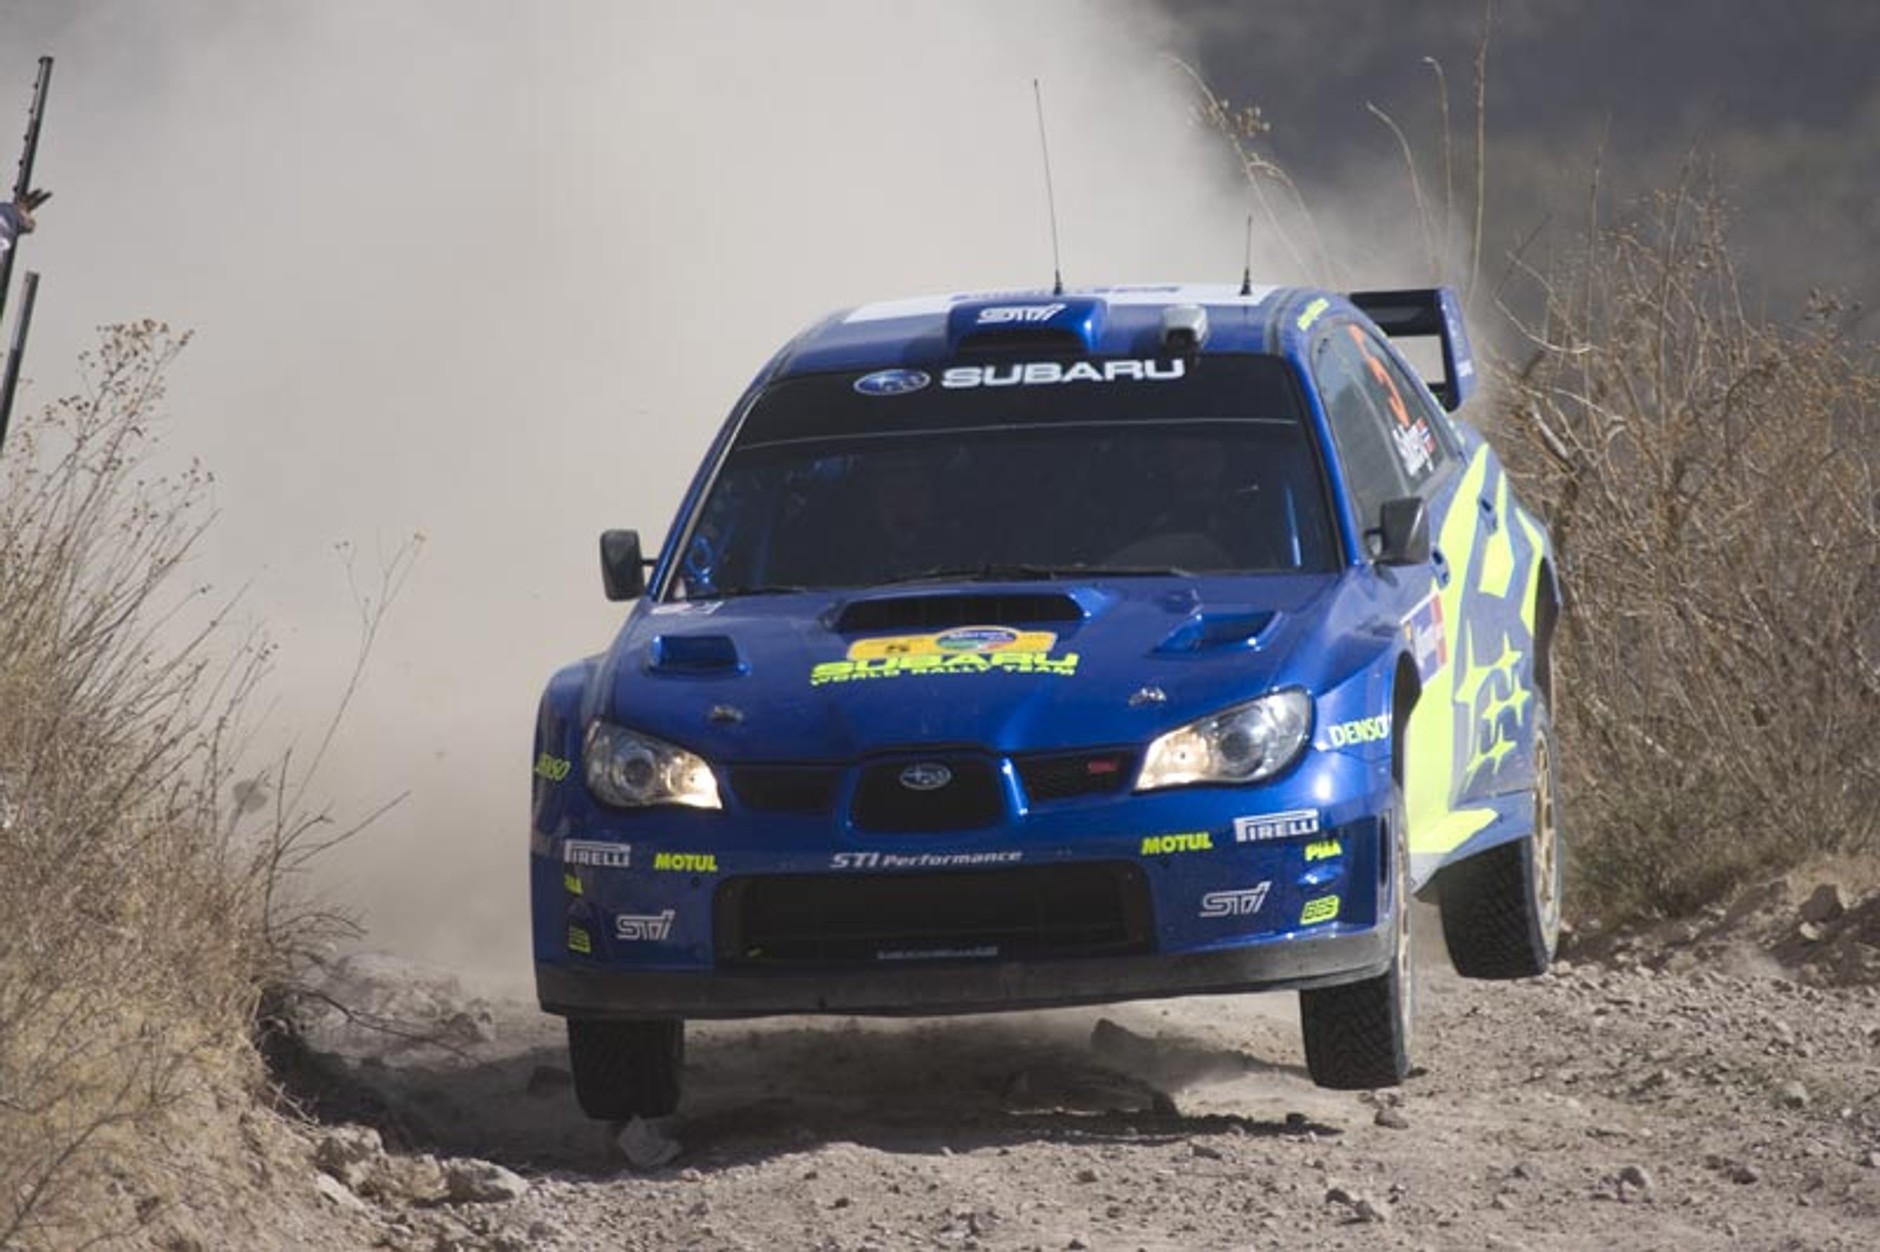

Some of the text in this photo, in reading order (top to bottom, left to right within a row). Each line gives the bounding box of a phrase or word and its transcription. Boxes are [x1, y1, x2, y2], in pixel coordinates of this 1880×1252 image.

[941, 358, 1185, 388] SUBARU
[811, 653, 1079, 677] SUBARU
[1329, 713, 1389, 748] DENSO
[1234, 808, 1319, 842] PIRELLI
[564, 839, 631, 867] PIRELLI
[1141, 832, 1214, 856] MOTUL
[654, 853, 718, 872] MOTUL
[829, 850, 1022, 868] STI Performance
